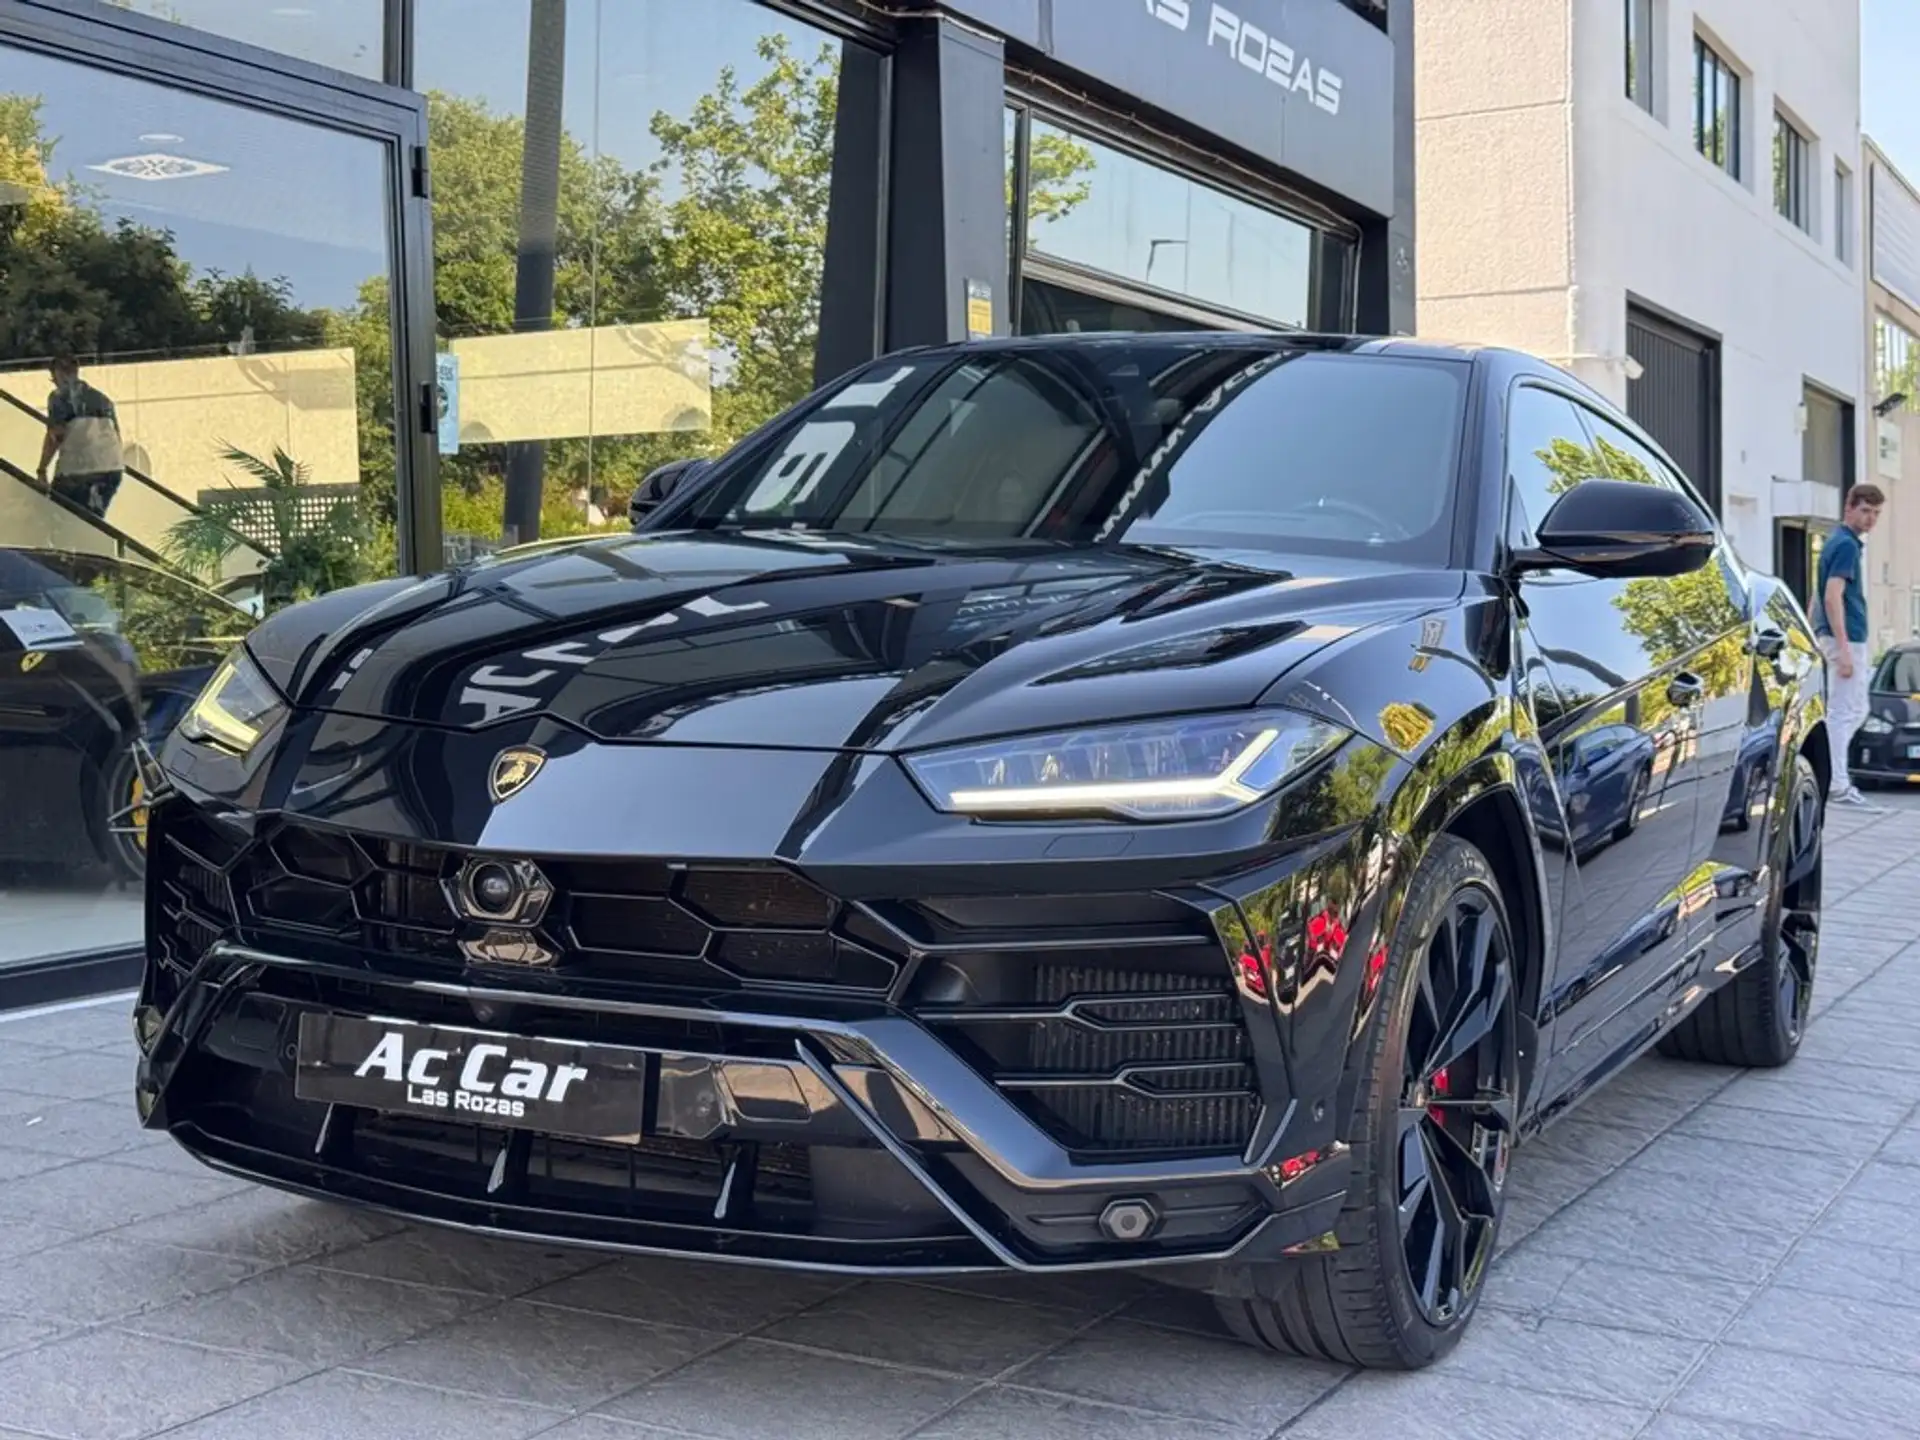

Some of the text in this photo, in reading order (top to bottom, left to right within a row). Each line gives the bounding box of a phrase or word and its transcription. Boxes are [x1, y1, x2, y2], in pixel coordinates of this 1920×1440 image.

[1207, 4, 1343, 115] ROZAS
[354, 1032, 588, 1102] Ac Car
[407, 1084, 525, 1117] Las Rozas
